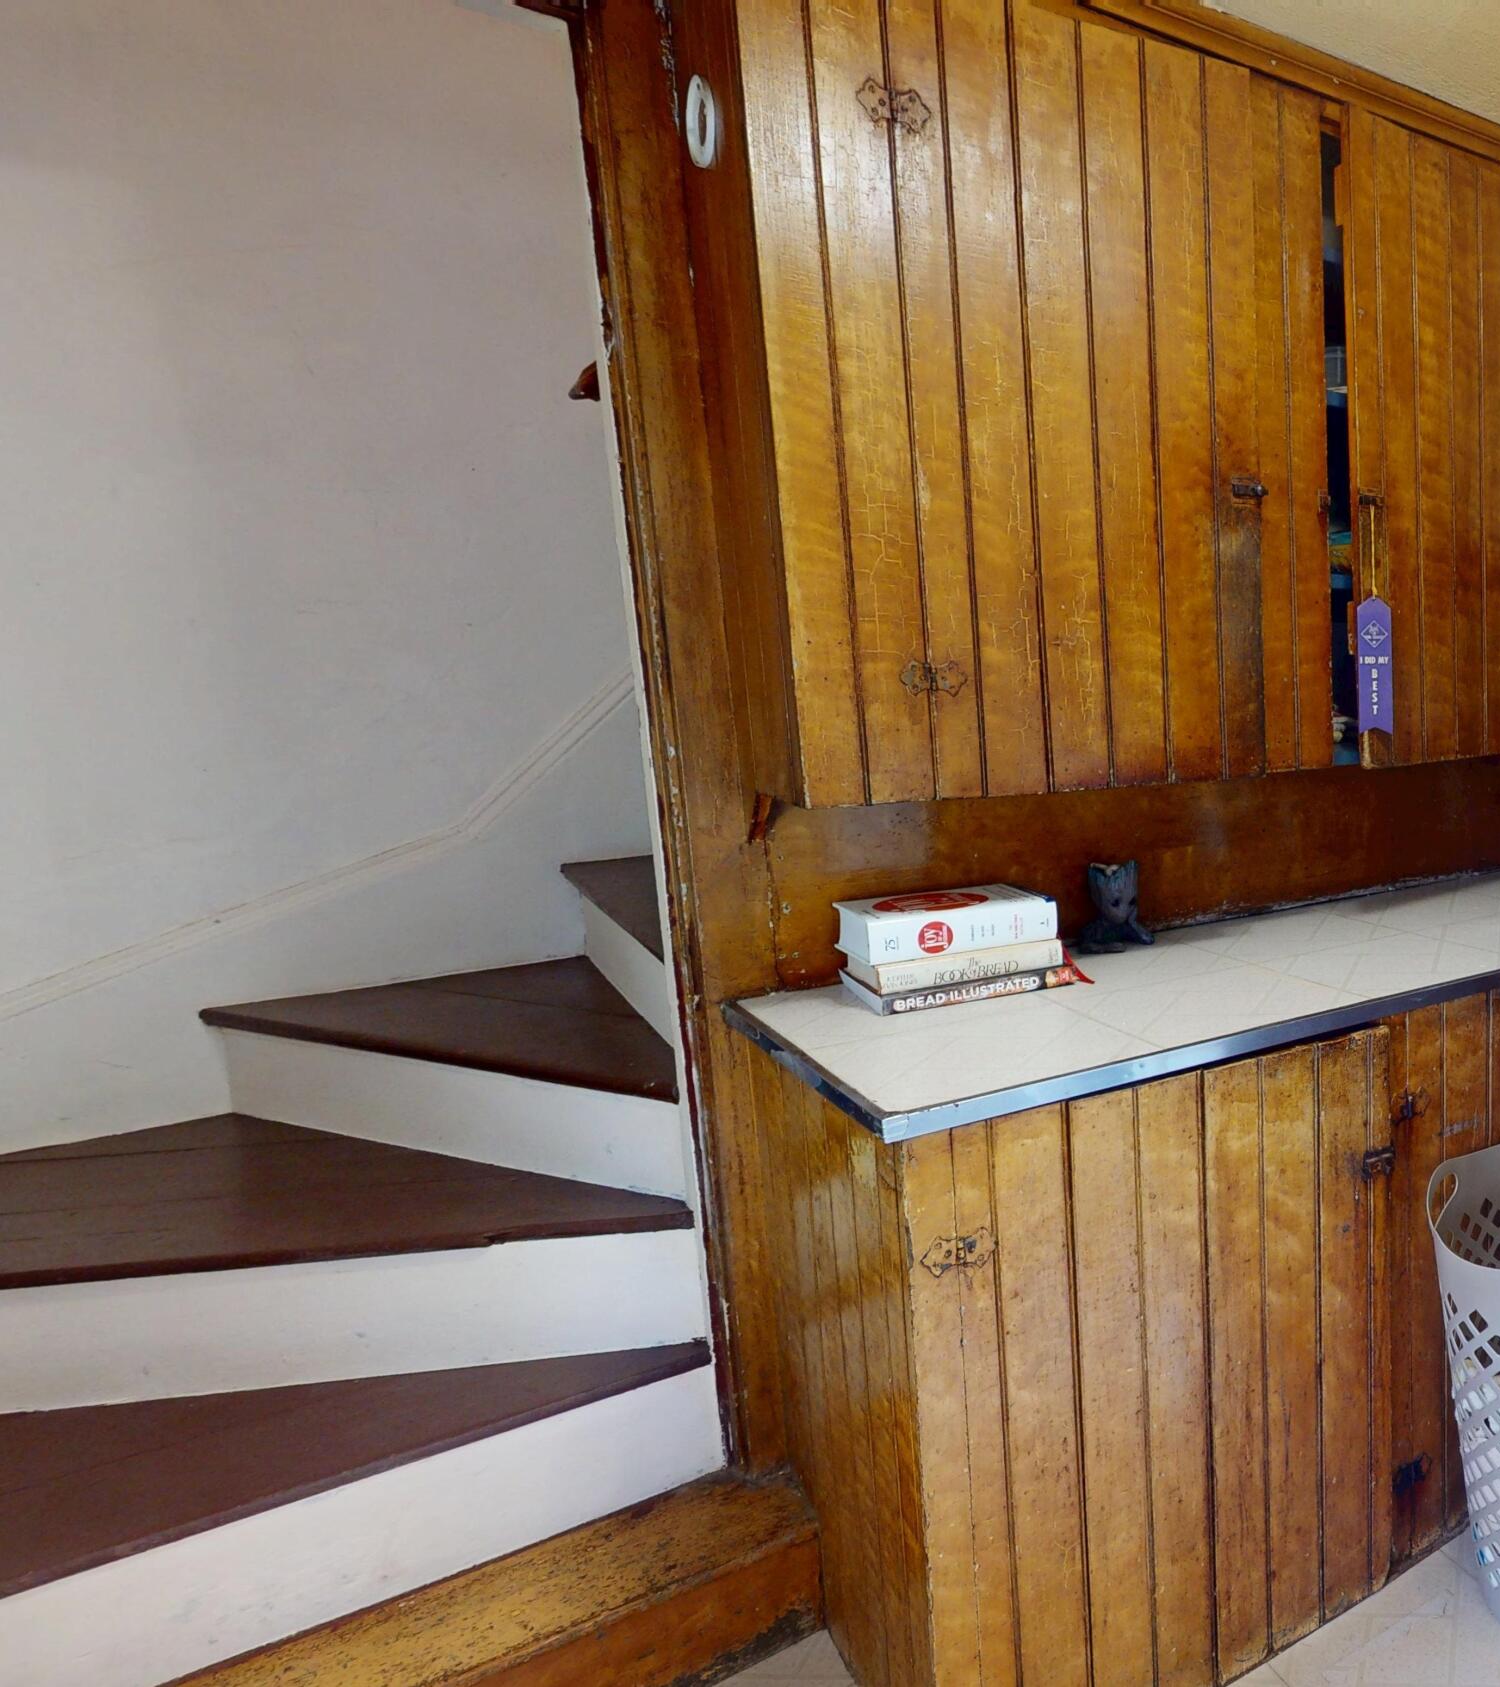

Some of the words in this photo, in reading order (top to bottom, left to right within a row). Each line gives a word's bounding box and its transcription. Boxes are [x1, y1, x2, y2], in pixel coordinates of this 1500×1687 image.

[1364, 656, 1376, 664] DID
[1377, 656, 1389, 664] MY
[1371, 668, 1379, 715] BEST
[920, 927, 949, 950] joy
[934, 968, 970, 985] BOOK
[977, 960, 1019, 978] BREAD
[894, 993, 946, 1012] BREAD
[950, 976, 1040, 1001] ILLUSTRATED
